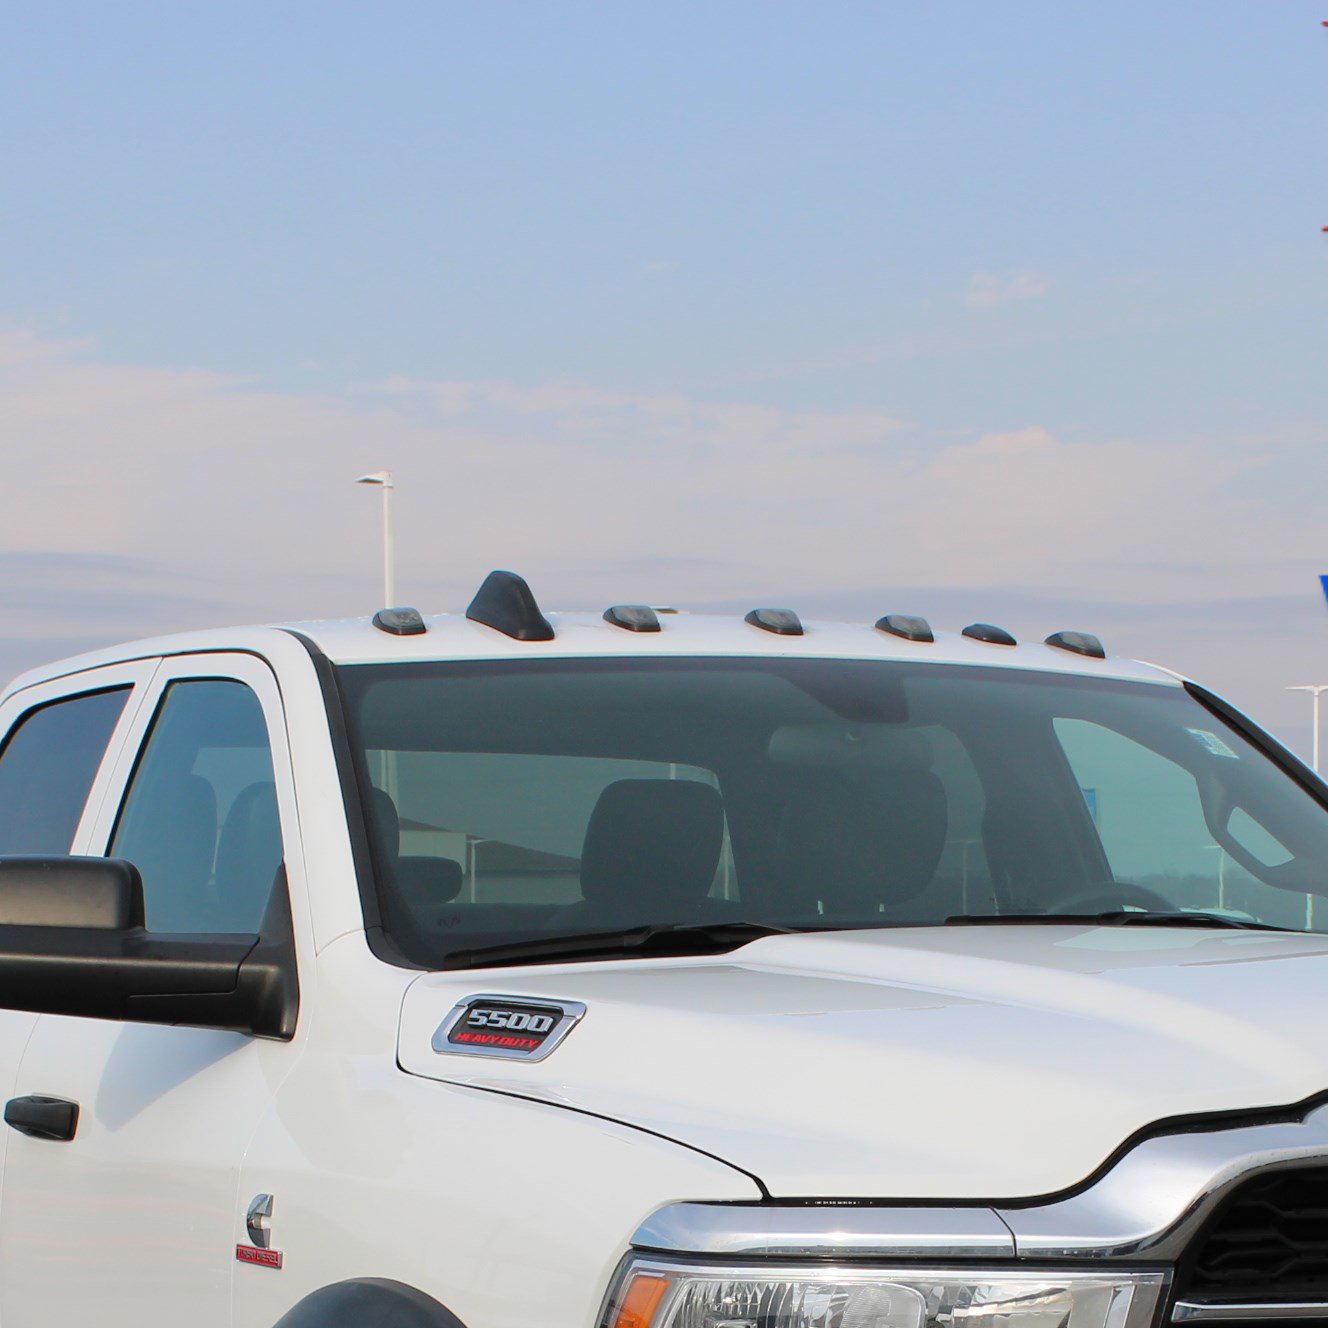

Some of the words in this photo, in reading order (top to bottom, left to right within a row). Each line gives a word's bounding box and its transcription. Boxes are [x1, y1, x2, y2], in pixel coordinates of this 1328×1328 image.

[467, 1009, 554, 1033] 5500
[454, 1032, 499, 1046] HEAVY
[498, 1037, 539, 1049] DUTY
